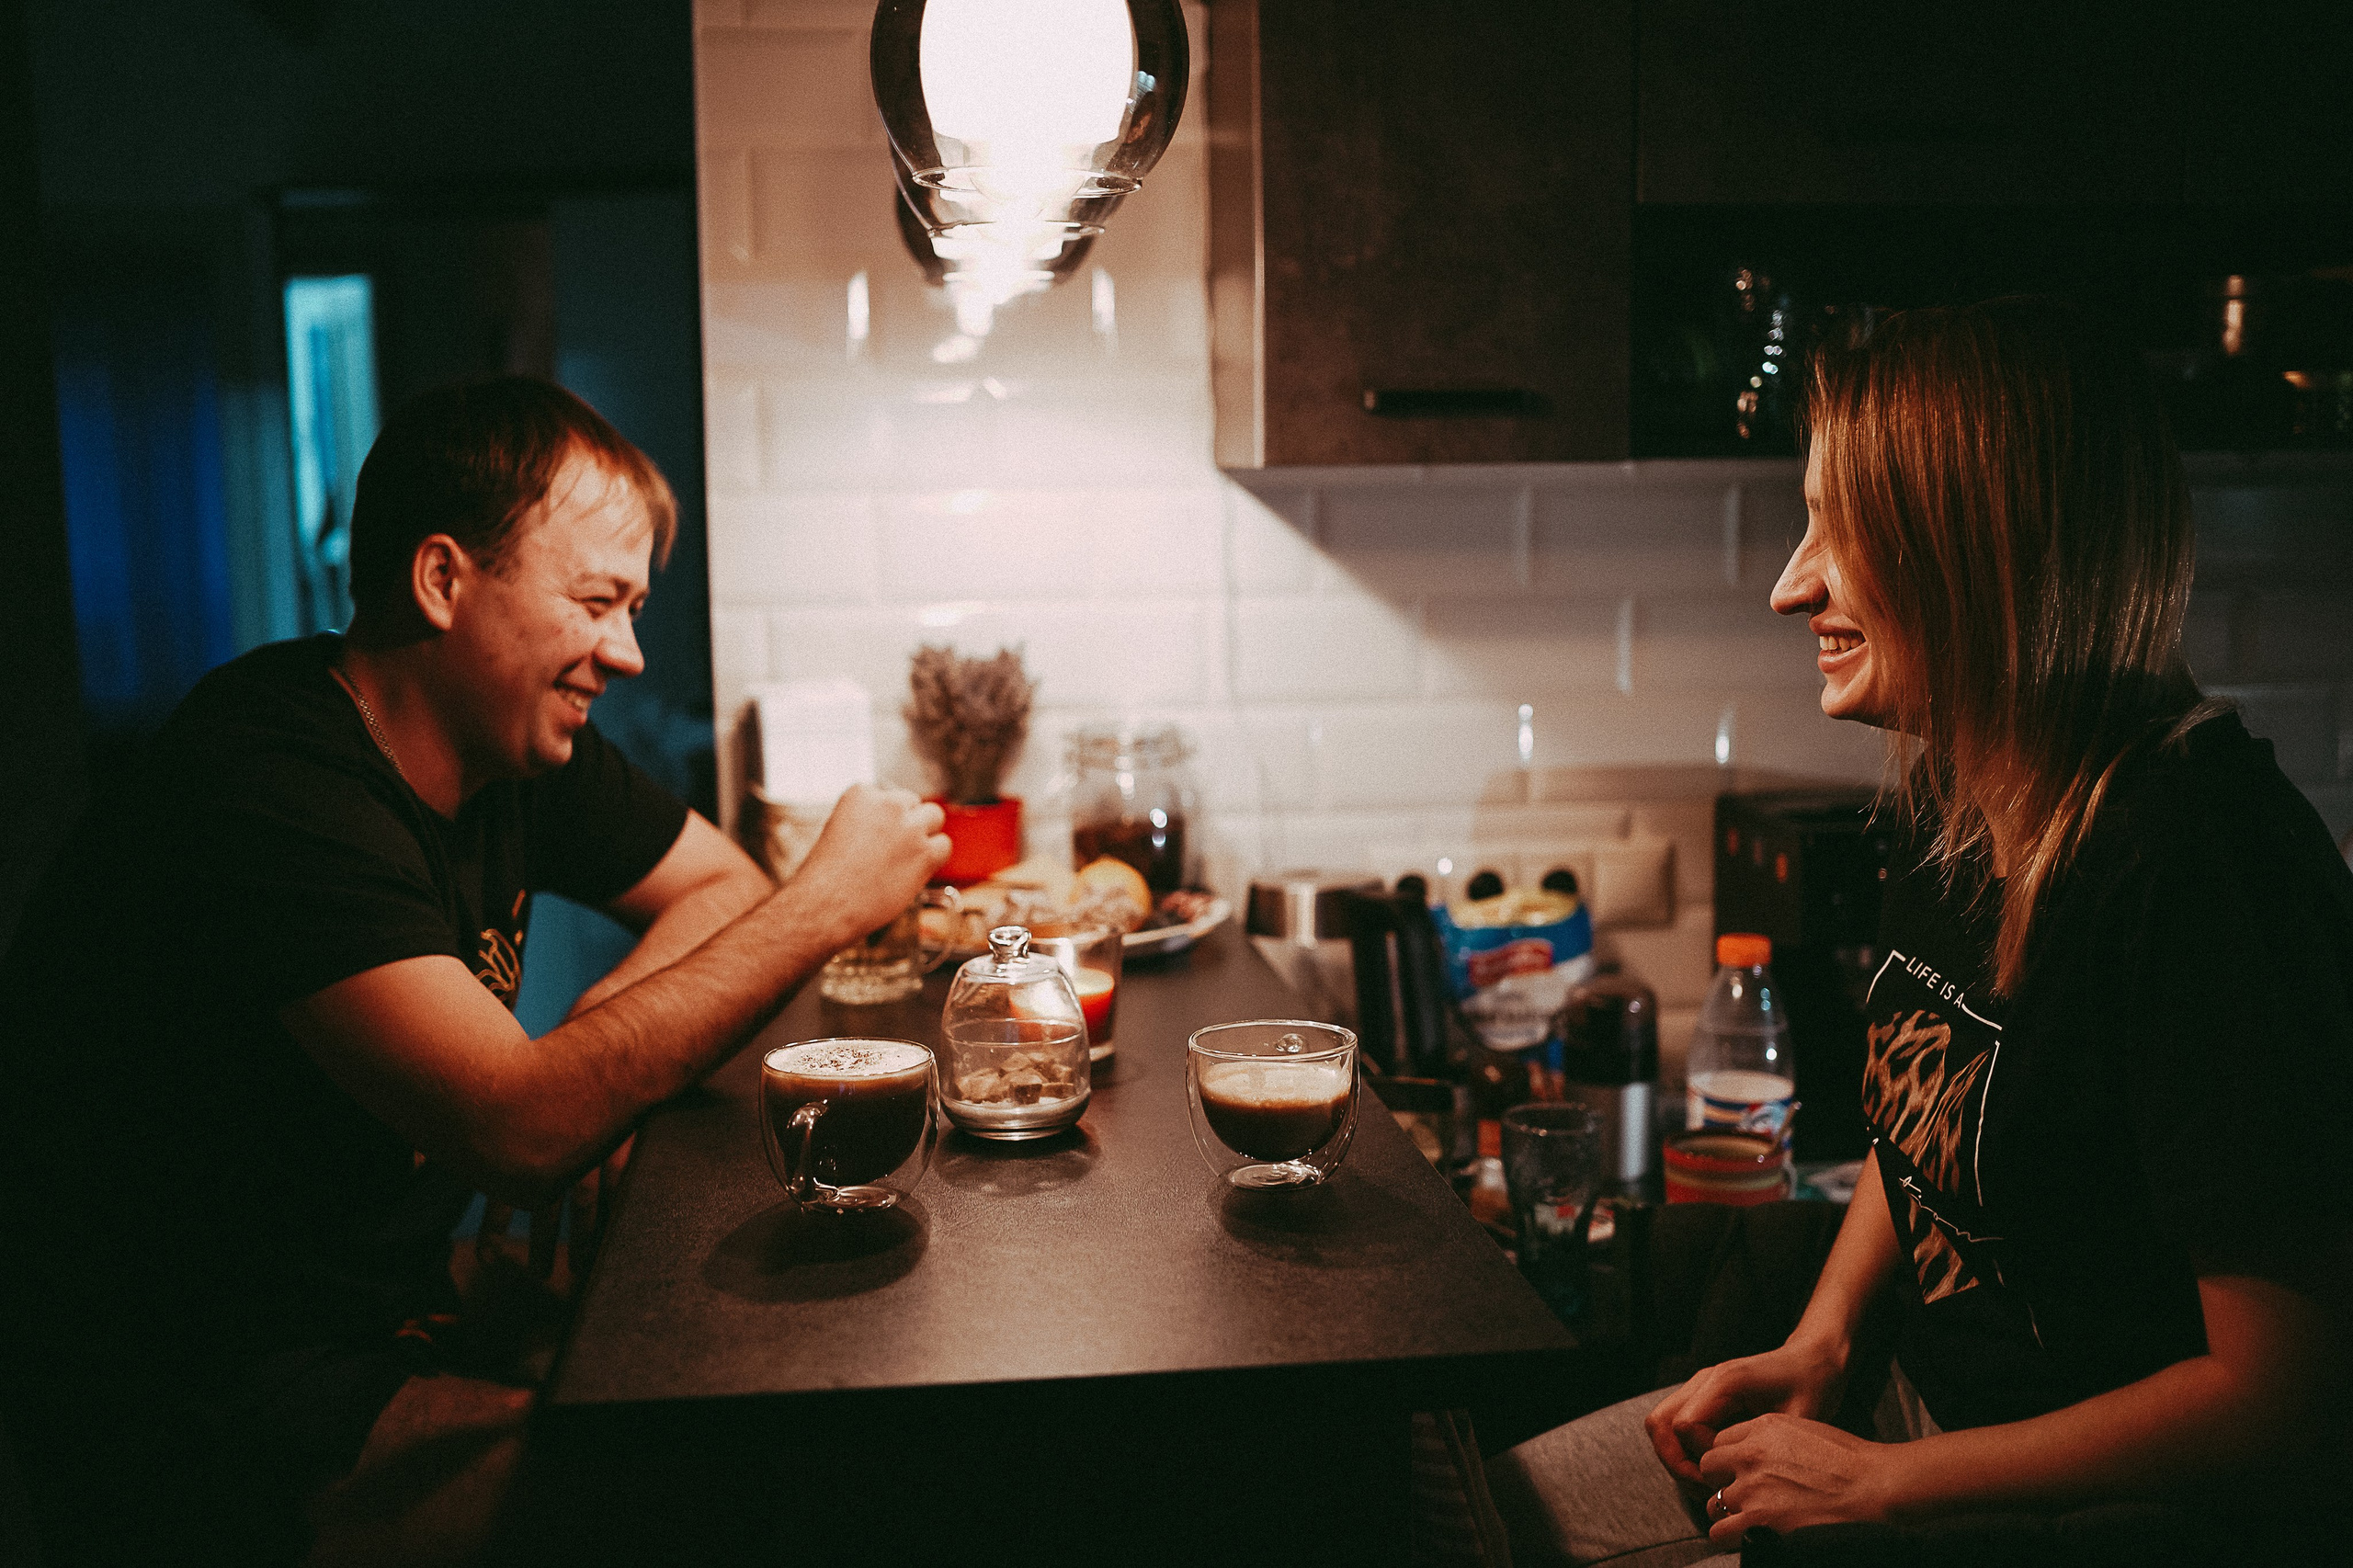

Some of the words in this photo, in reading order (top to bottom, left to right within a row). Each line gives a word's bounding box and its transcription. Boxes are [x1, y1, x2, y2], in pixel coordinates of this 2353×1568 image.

[1905, 956, 1941, 990] LIFE
[1939, 981, 1956, 1000] IS
[1953, 992, 1964, 1008] A
